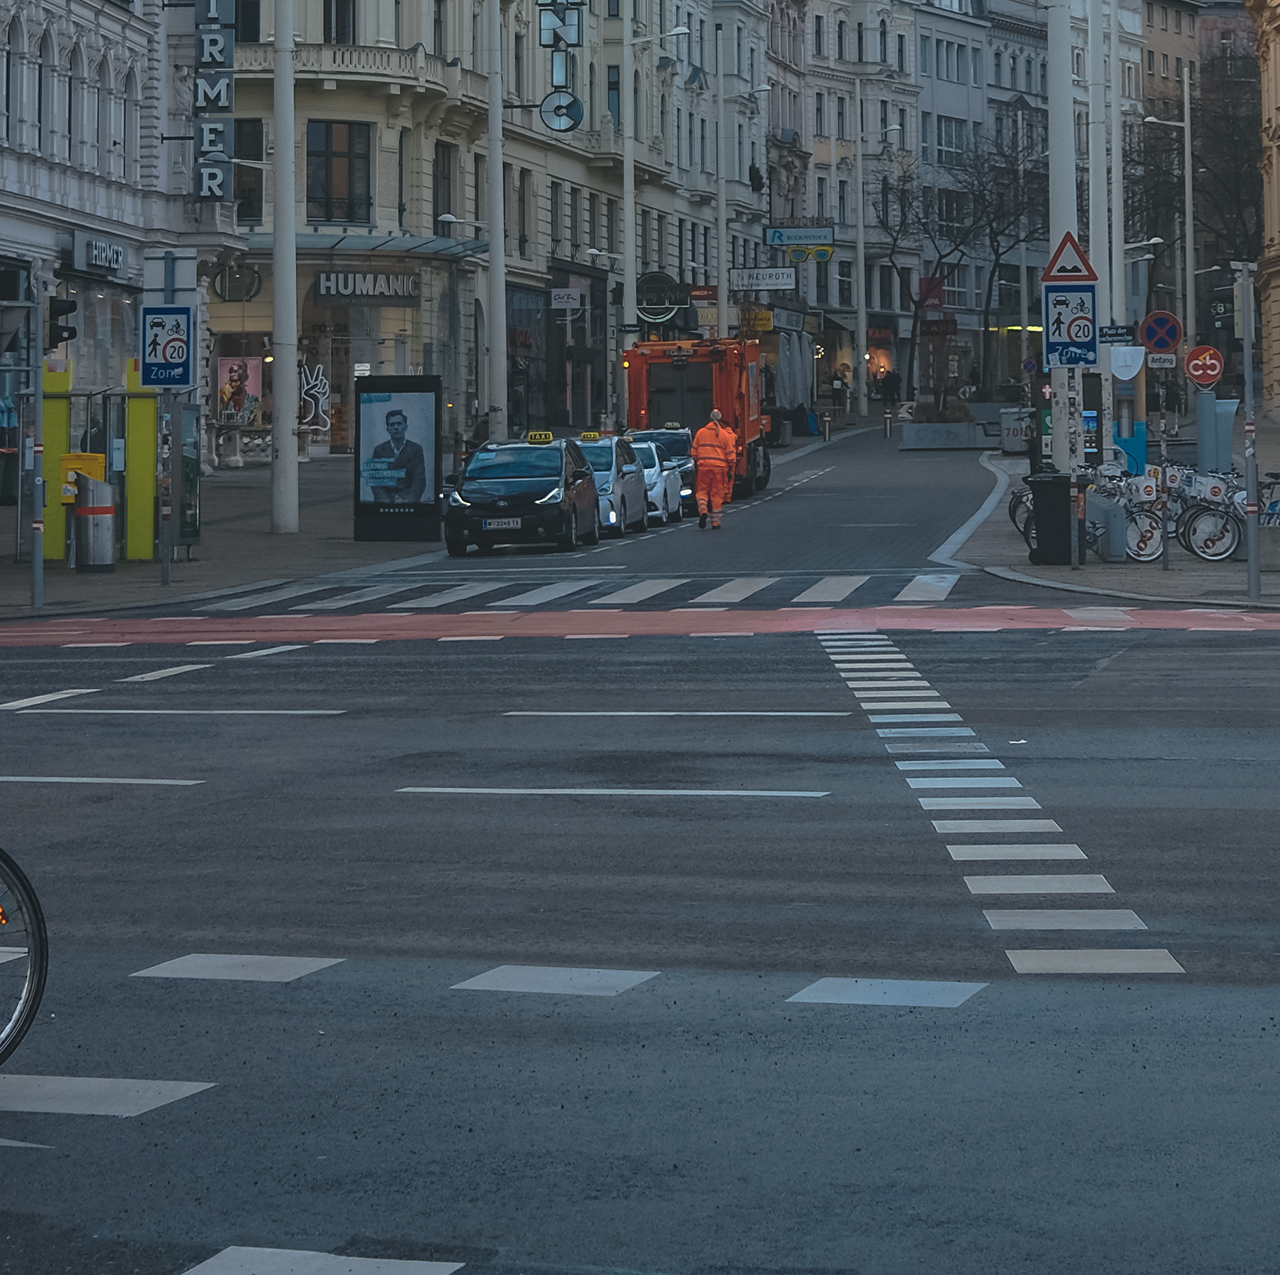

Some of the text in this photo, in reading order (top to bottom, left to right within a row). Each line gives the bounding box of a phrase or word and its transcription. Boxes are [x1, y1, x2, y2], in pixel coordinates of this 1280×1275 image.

[92, 240, 124, 269] HIRMER
[748, 272, 792, 281] NEUROTH
[319, 272, 421, 298] HUMANIC
[553, 293, 578, 302] ara
[1074, 323, 1090, 338] 20
[169, 345, 185, 359] 20
[1151, 356, 1174, 366] Anfang
[364, 462, 388, 470] LUDWIG
[362, 470, 405, 479] WITTGENSTEIN
